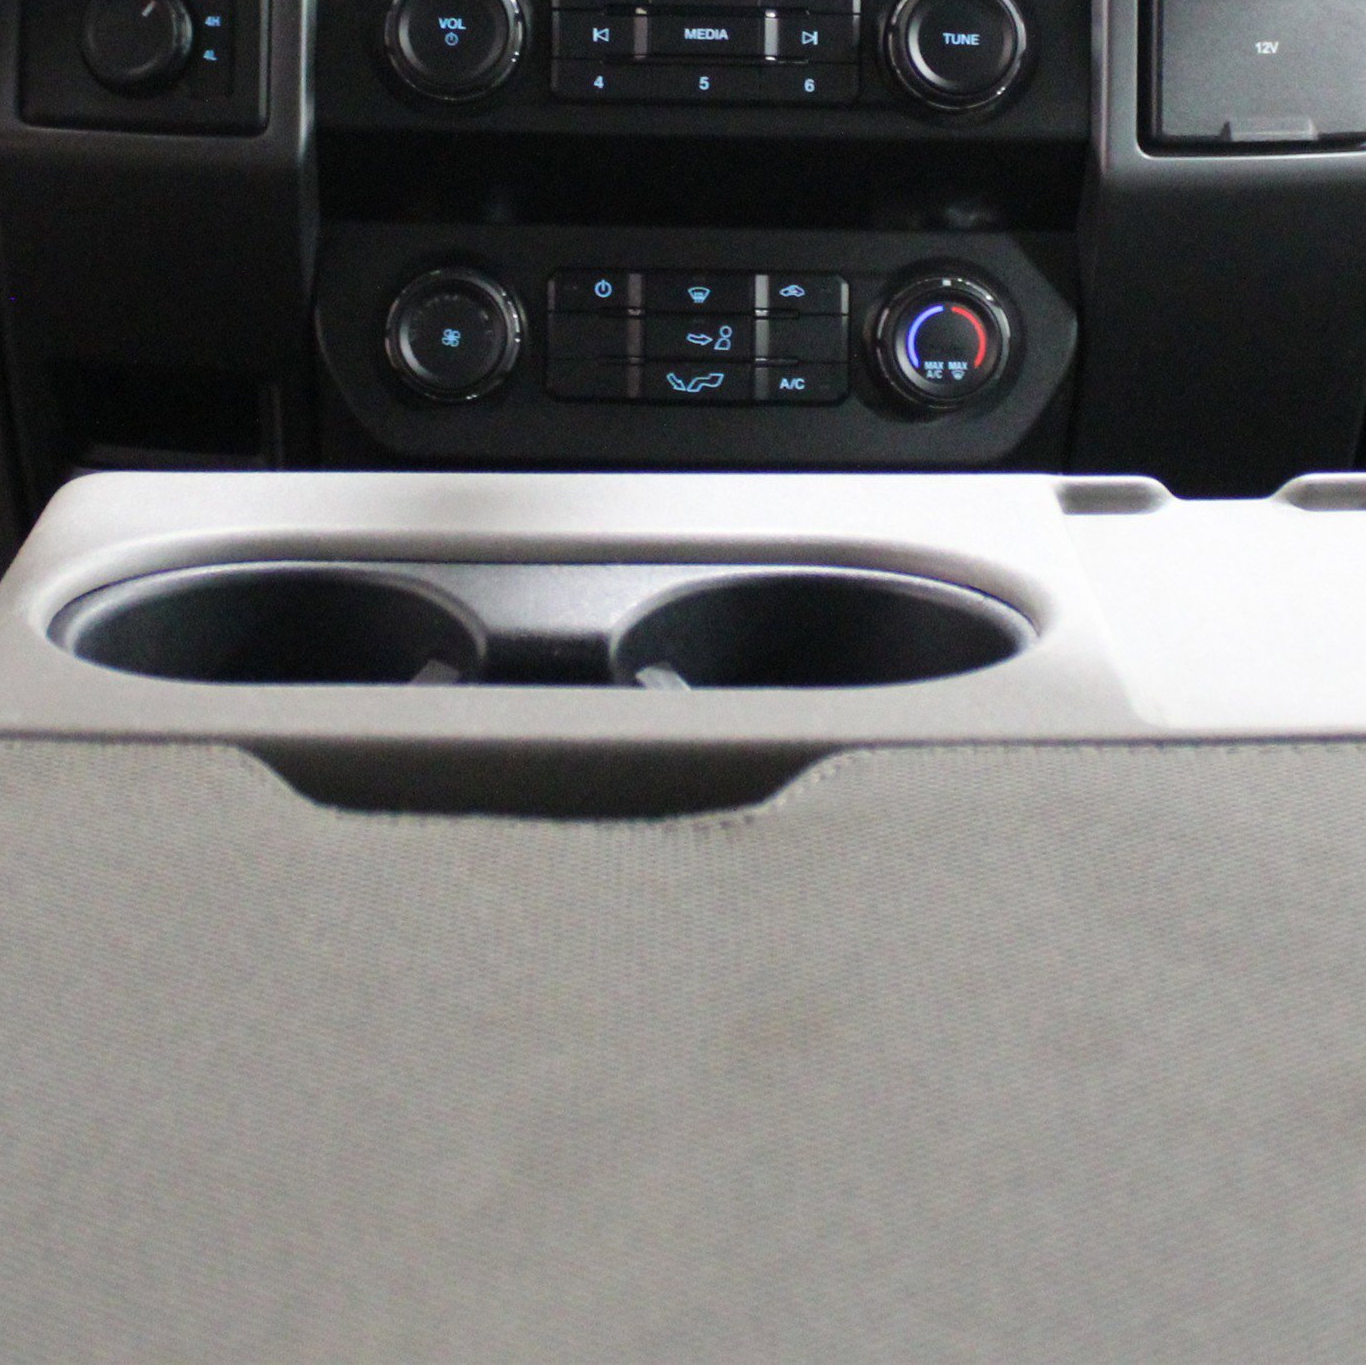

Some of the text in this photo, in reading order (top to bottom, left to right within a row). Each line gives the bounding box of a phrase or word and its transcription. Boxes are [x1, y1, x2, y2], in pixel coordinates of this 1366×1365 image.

[204, 16, 221, 27] 4H
[438, 17, 466, 30] VOL
[684, 28, 728, 40] MEDIA
[942, 32, 980, 46] TUNE
[1255, 41, 1278, 54] 12V
[593, 75, 604, 89] 4
[698, 76, 710, 90] 5
[804, 78, 815, 93] 6
[924, 361, 968, 371] MAX MAX
[926, 369, 943, 379] A/C
[779, 377, 805, 390] A/C
